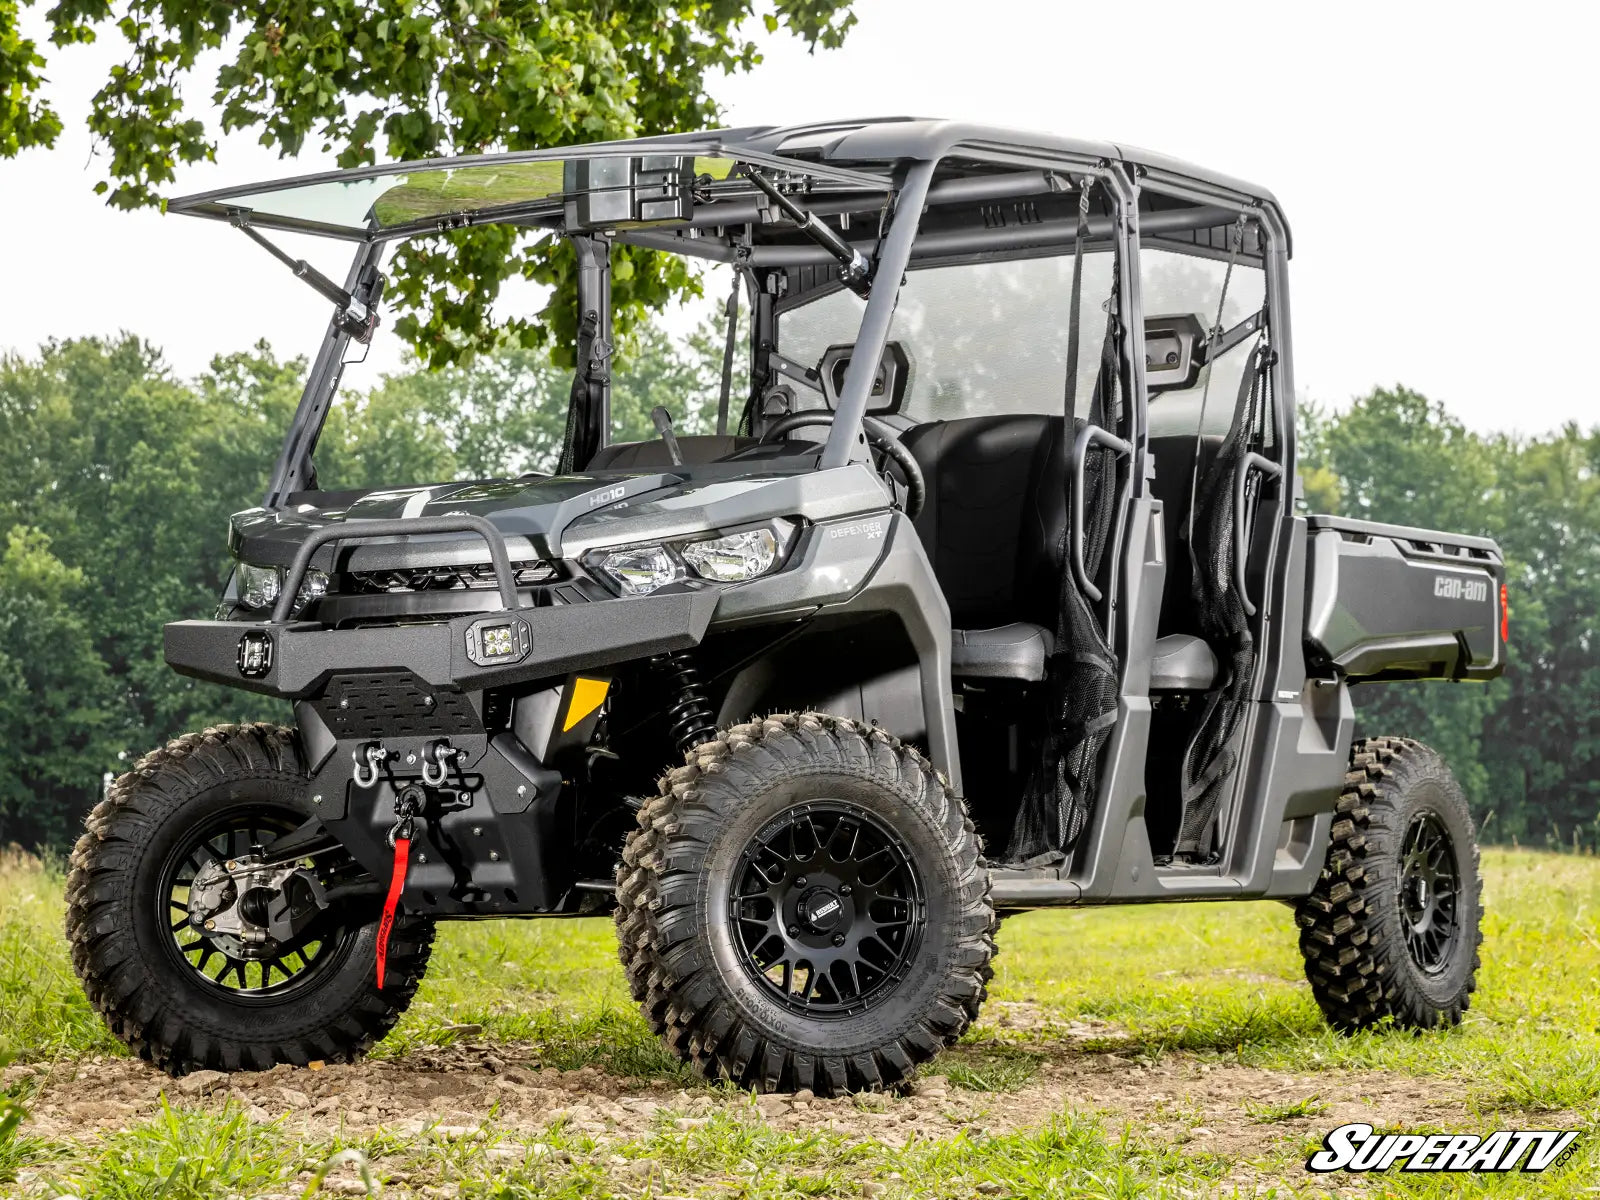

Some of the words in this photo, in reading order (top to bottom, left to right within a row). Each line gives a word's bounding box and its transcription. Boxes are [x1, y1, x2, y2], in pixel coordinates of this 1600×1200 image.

[830, 522, 882, 539] DEFENDER
[867, 530, 883, 539] XT
[1434, 577, 1487, 602] can-am
